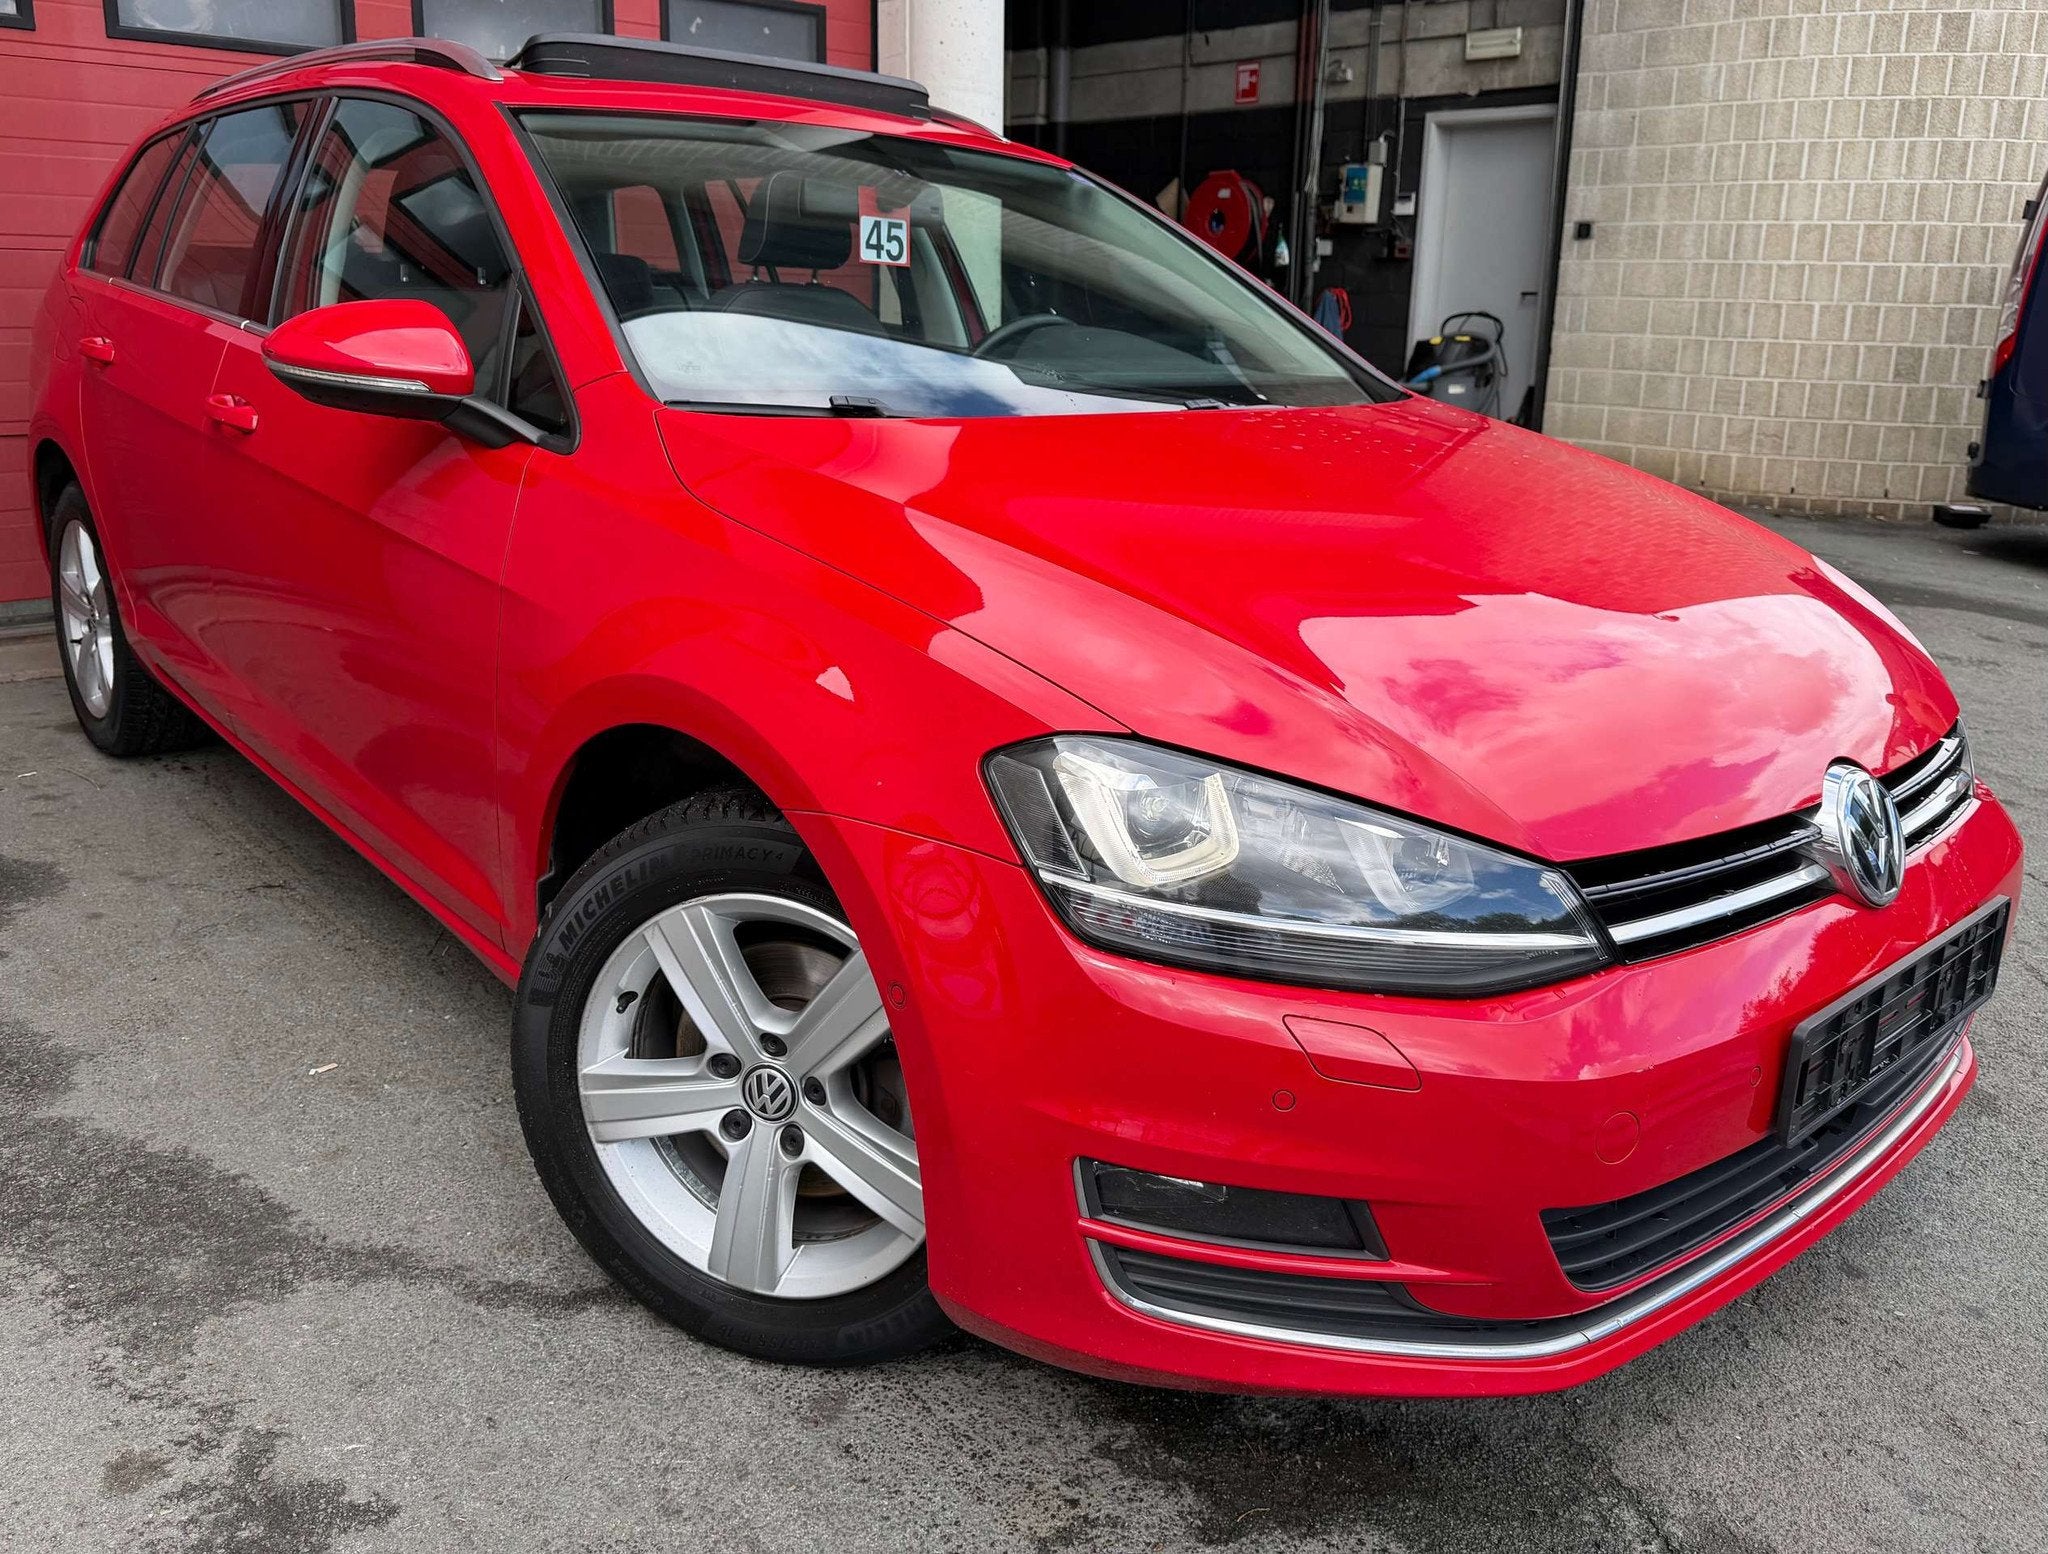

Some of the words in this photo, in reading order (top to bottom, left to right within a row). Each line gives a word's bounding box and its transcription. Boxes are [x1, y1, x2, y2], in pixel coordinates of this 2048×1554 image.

[865, 220, 904, 262] 45
[558, 853, 672, 952] MICHELIN
[690, 845, 773, 862] PRIMACY
